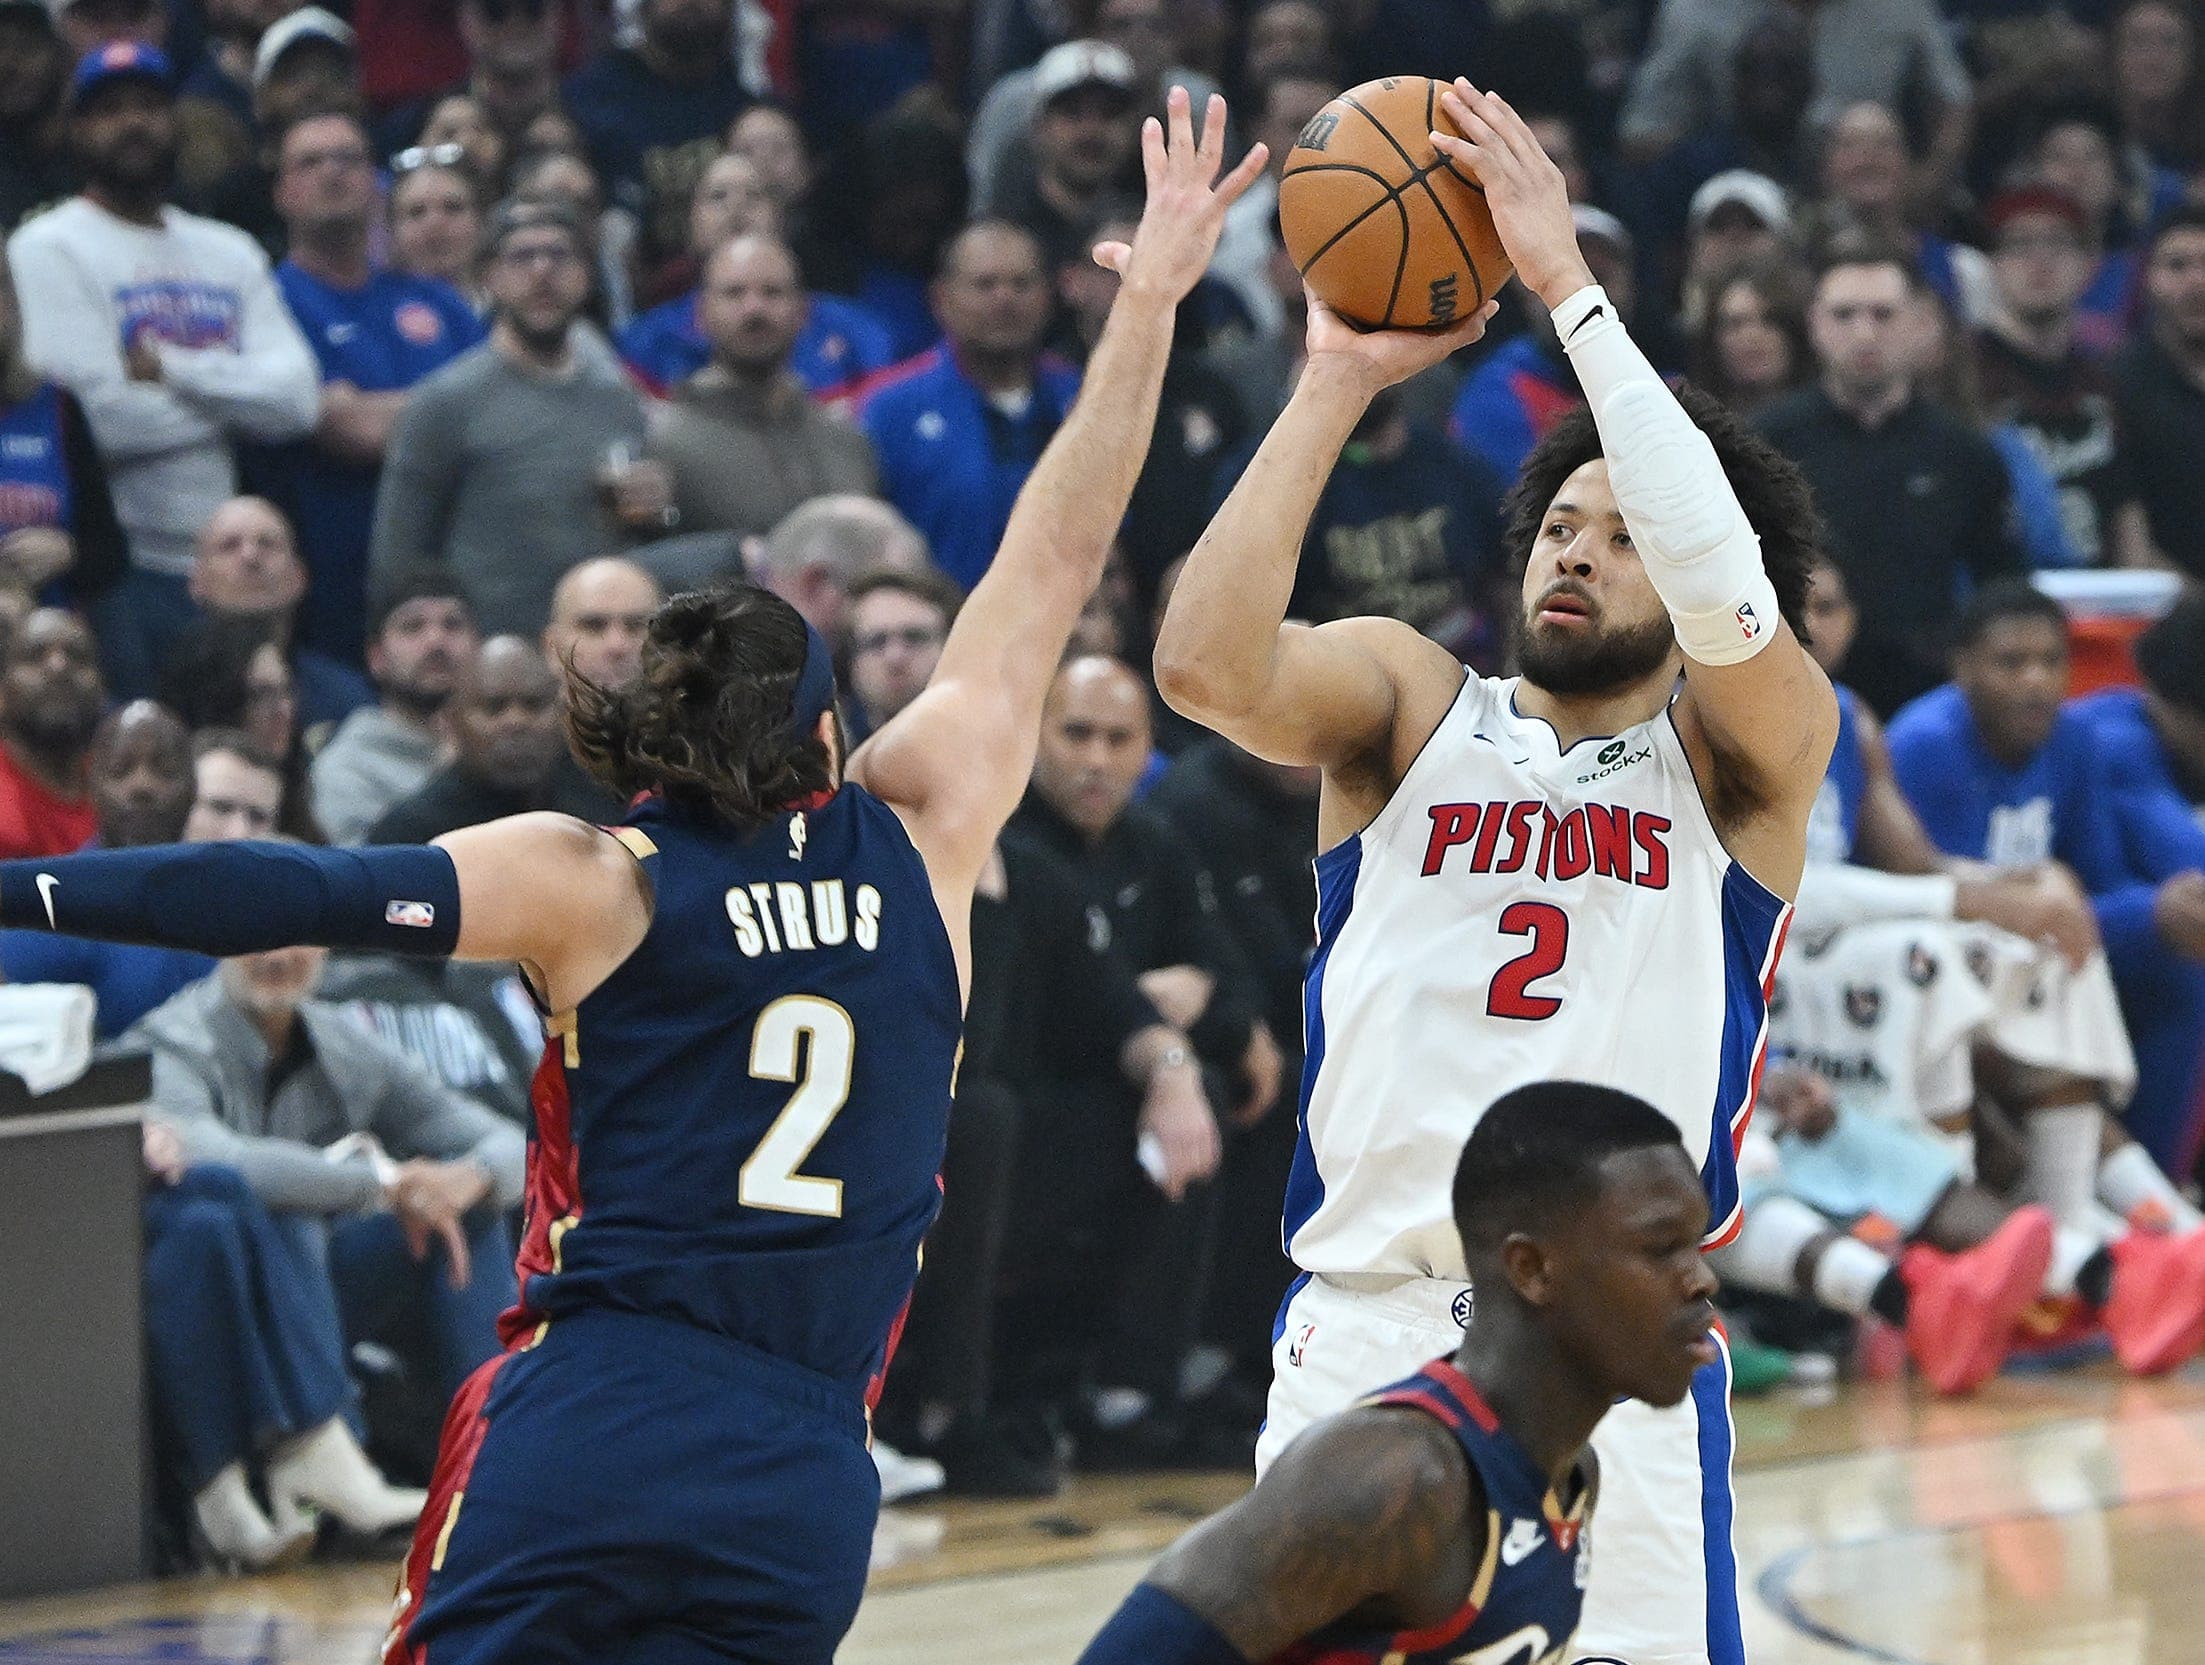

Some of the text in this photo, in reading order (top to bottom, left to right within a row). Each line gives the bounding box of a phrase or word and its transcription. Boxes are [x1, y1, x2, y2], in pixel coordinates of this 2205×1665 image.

[1421, 801, 1672, 889] PISTONS
[725, 879, 882, 957] STRUS
[1486, 901, 1569, 1021] 2
[739, 993, 855, 1217] 2
